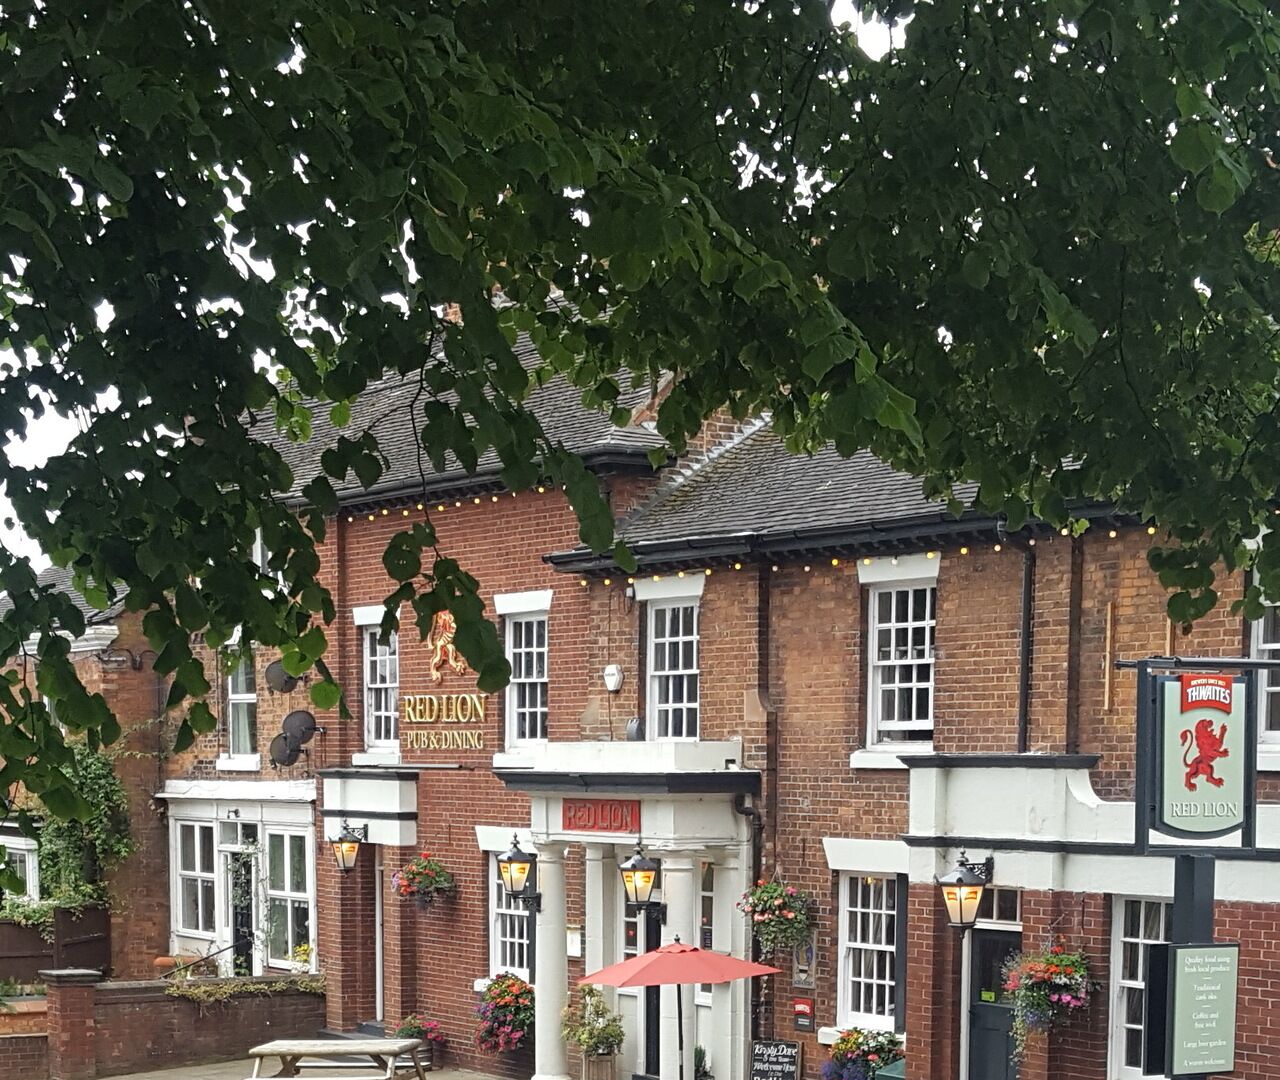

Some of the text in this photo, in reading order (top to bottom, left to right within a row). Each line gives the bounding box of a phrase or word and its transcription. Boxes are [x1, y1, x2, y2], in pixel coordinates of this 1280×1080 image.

[1186, 685, 1231, 704] THWAITES
[403, 693, 487, 723] RED LION
[407, 730, 484, 749] PUB & DINING
[566, 803, 633, 831] RED LION
[1171, 802, 1238, 818] RED LION
